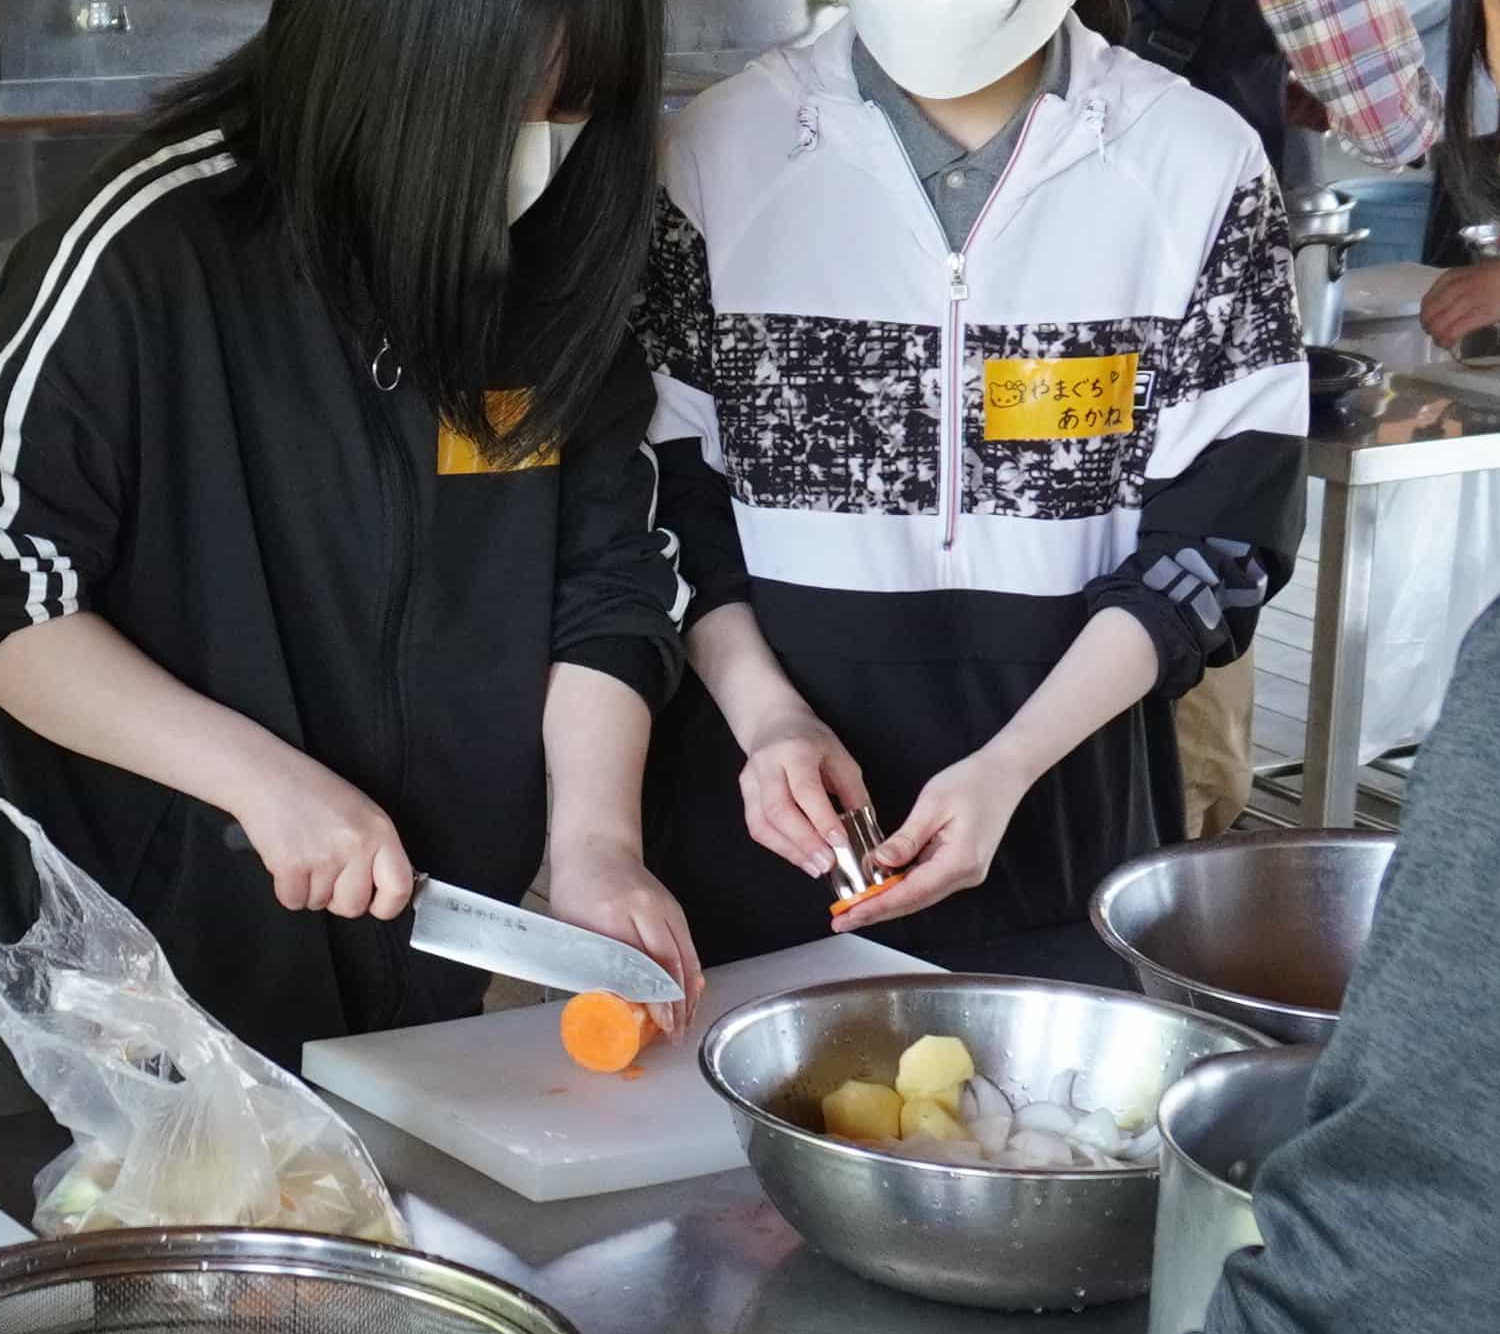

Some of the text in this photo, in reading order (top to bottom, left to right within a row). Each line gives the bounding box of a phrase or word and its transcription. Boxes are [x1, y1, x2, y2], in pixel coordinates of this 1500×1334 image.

[1031, 378, 1104, 401] やまぐち
[1057, 407, 1123, 430] あかね
